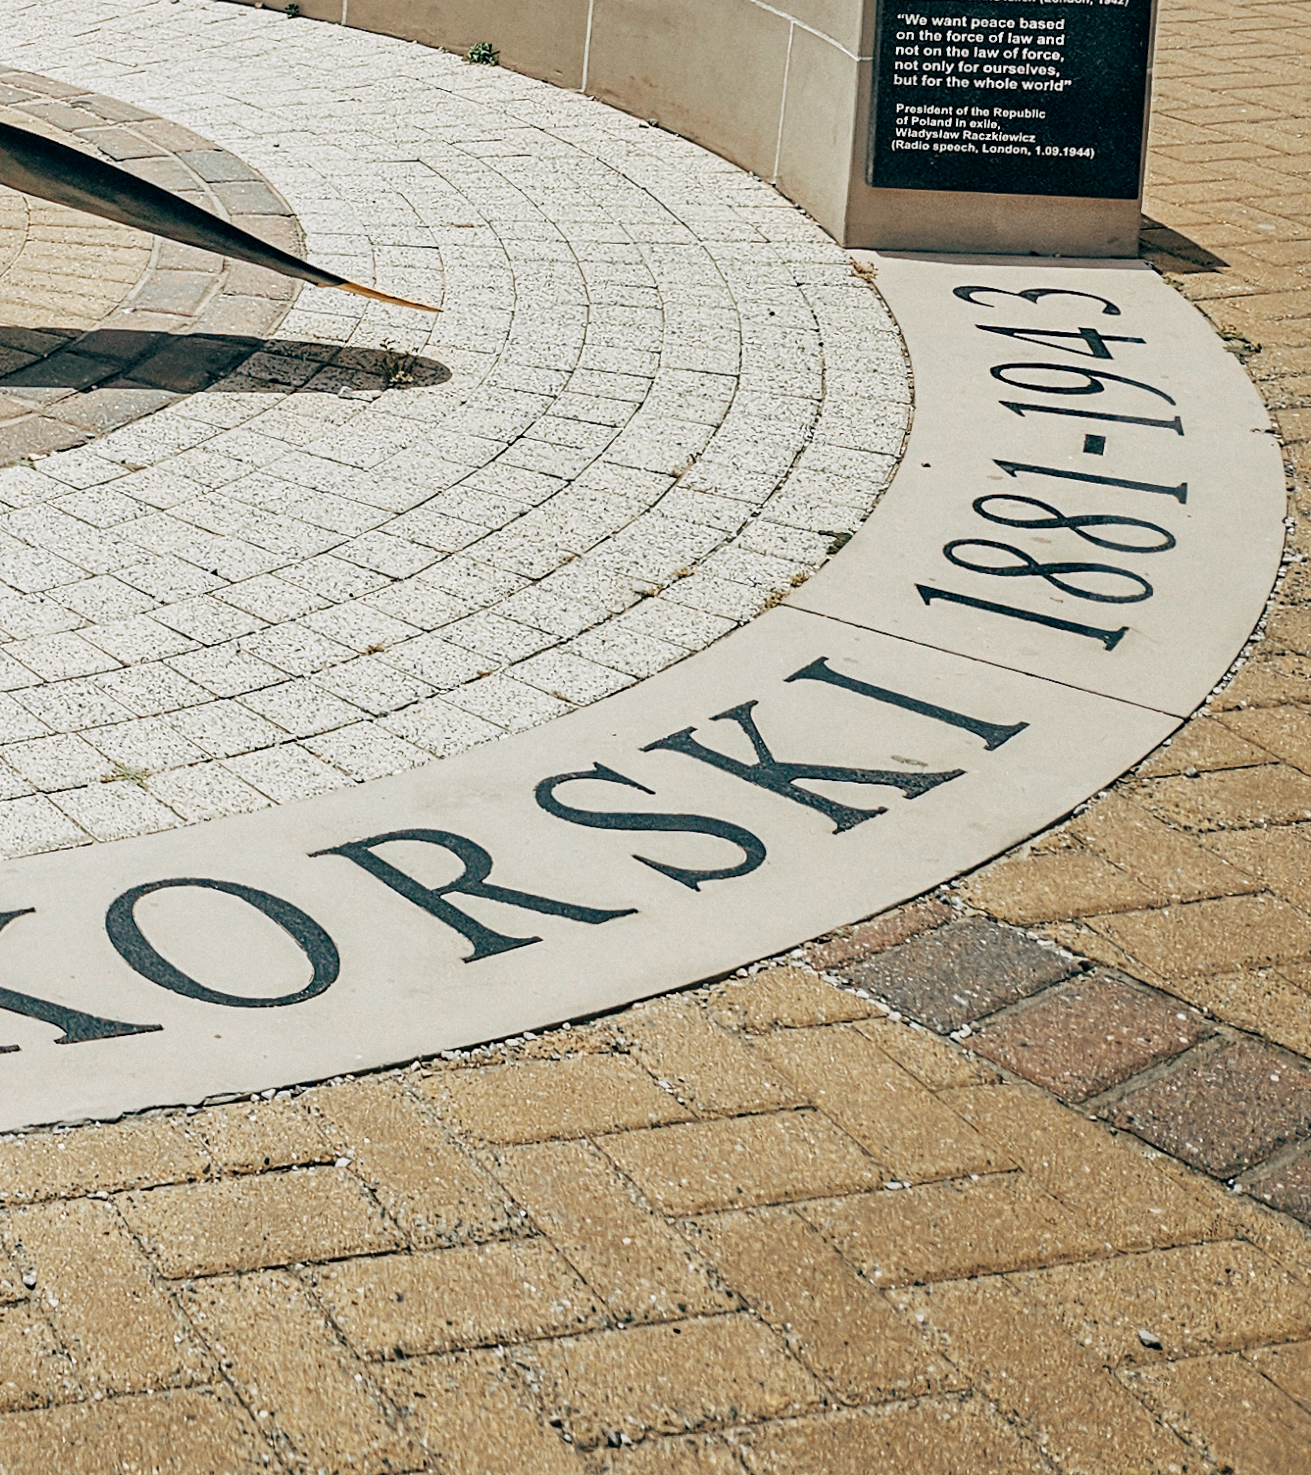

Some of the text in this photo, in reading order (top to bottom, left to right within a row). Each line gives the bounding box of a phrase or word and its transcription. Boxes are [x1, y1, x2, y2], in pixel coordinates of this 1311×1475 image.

[932, 16, 967, 27] want
[971, 18, 1015, 30] peace
[1020, 17, 1065, 30] based
[896, 30, 1065, 45] on the force of law and
[895, 45, 1064, 62] not on the law of force,
[895, 60, 1060, 77] not only for ourselves,
[893, 74, 918, 85] but
[921, 75, 943, 86] for
[946, 76, 969, 88] the
[974, 77, 1018, 89] whole
[915, 282, 1186, 652] 1881-1943
